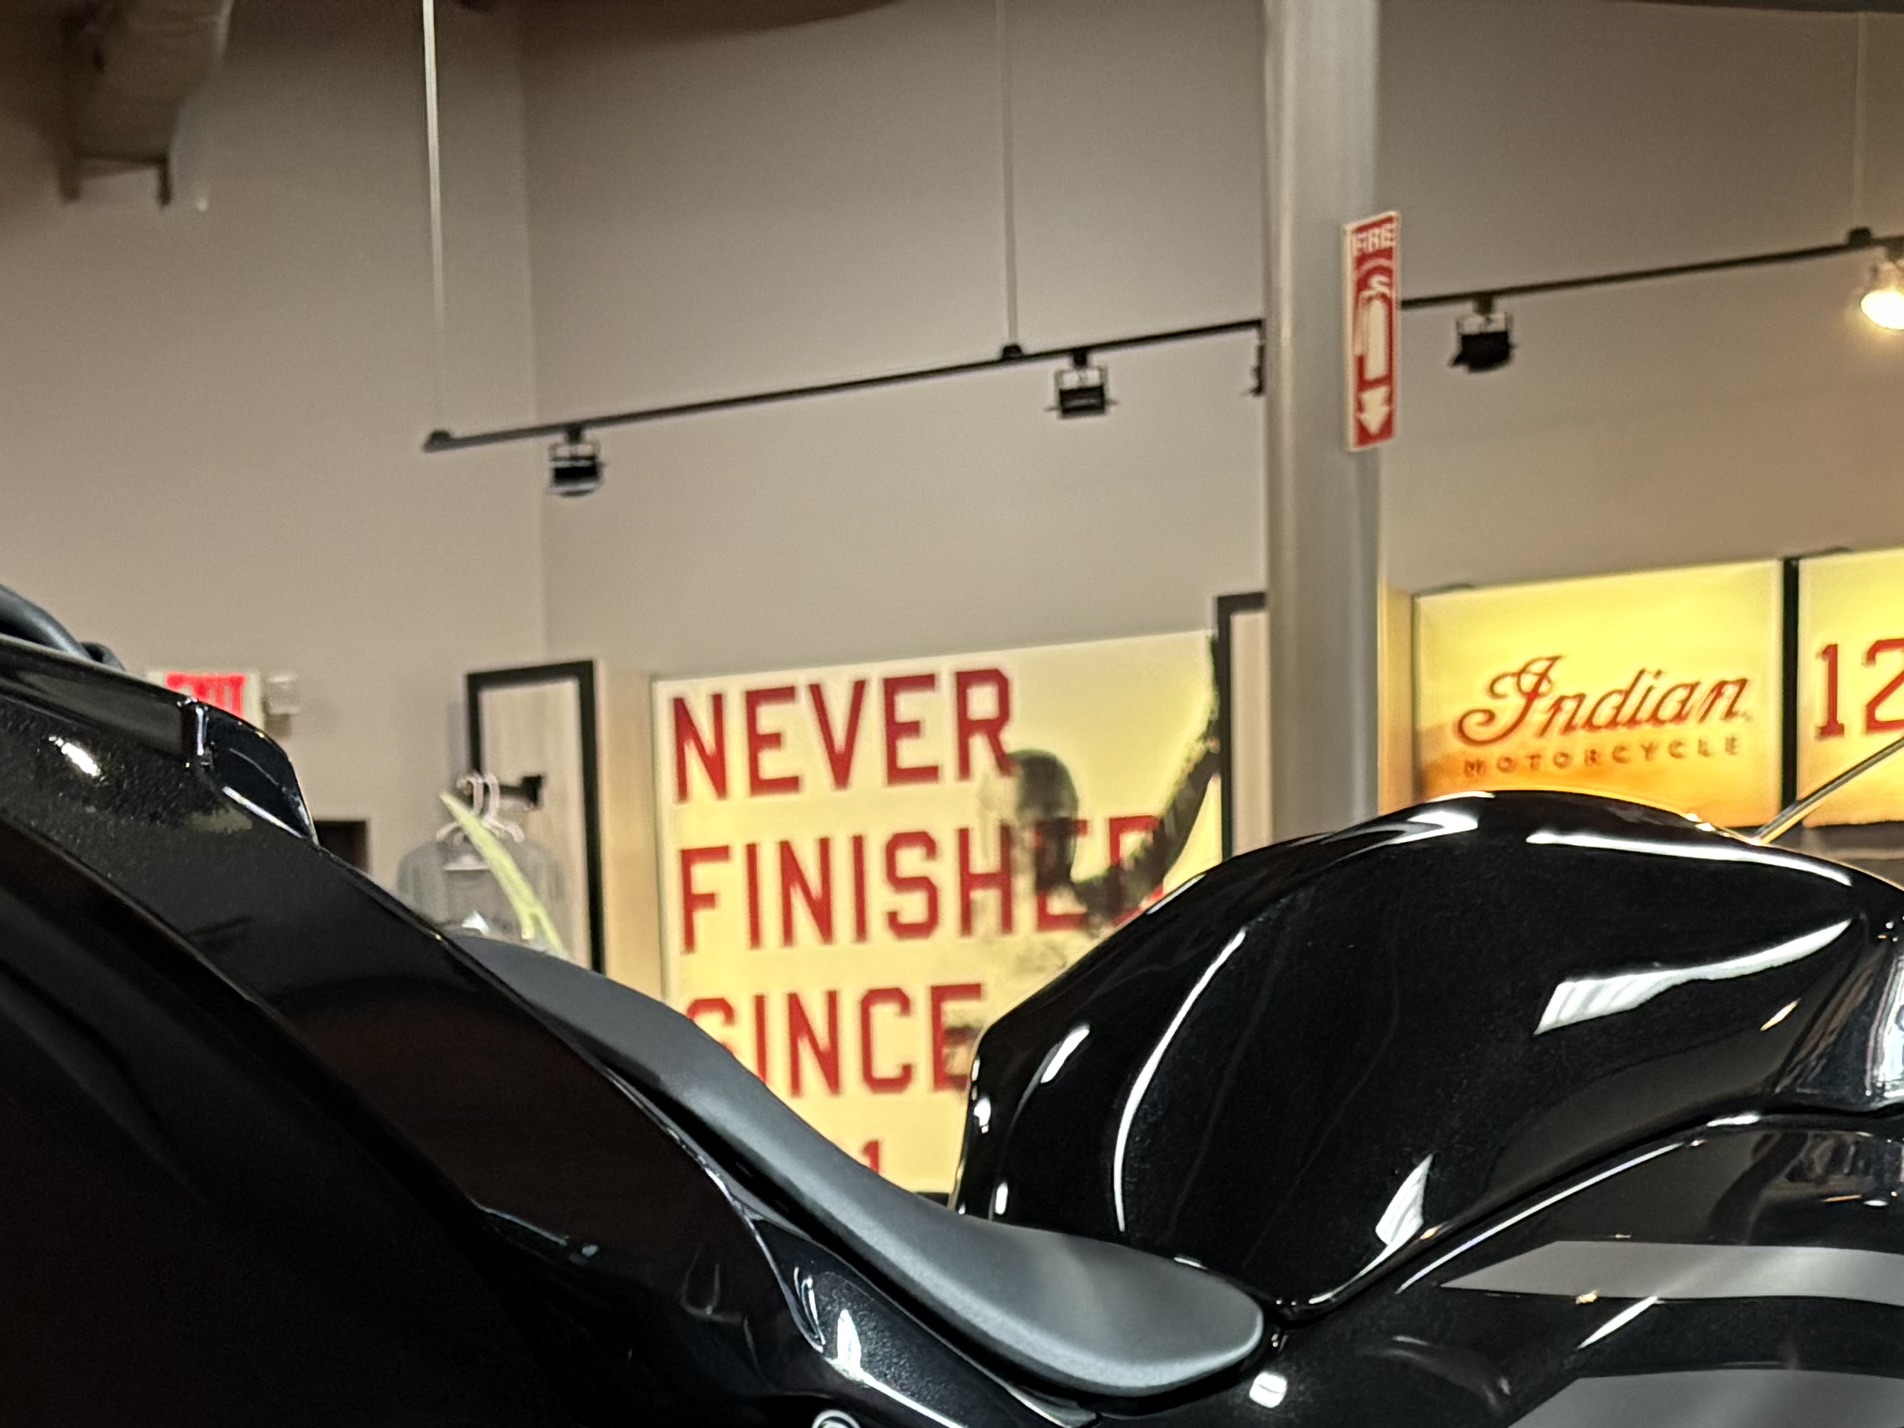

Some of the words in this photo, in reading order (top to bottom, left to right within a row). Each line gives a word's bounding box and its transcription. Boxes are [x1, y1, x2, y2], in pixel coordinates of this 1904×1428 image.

[673, 668, 1016, 803] NEVER
[1456, 654, 1750, 747] Indian
[1464, 736, 1739, 777] MOTORCYCLE
